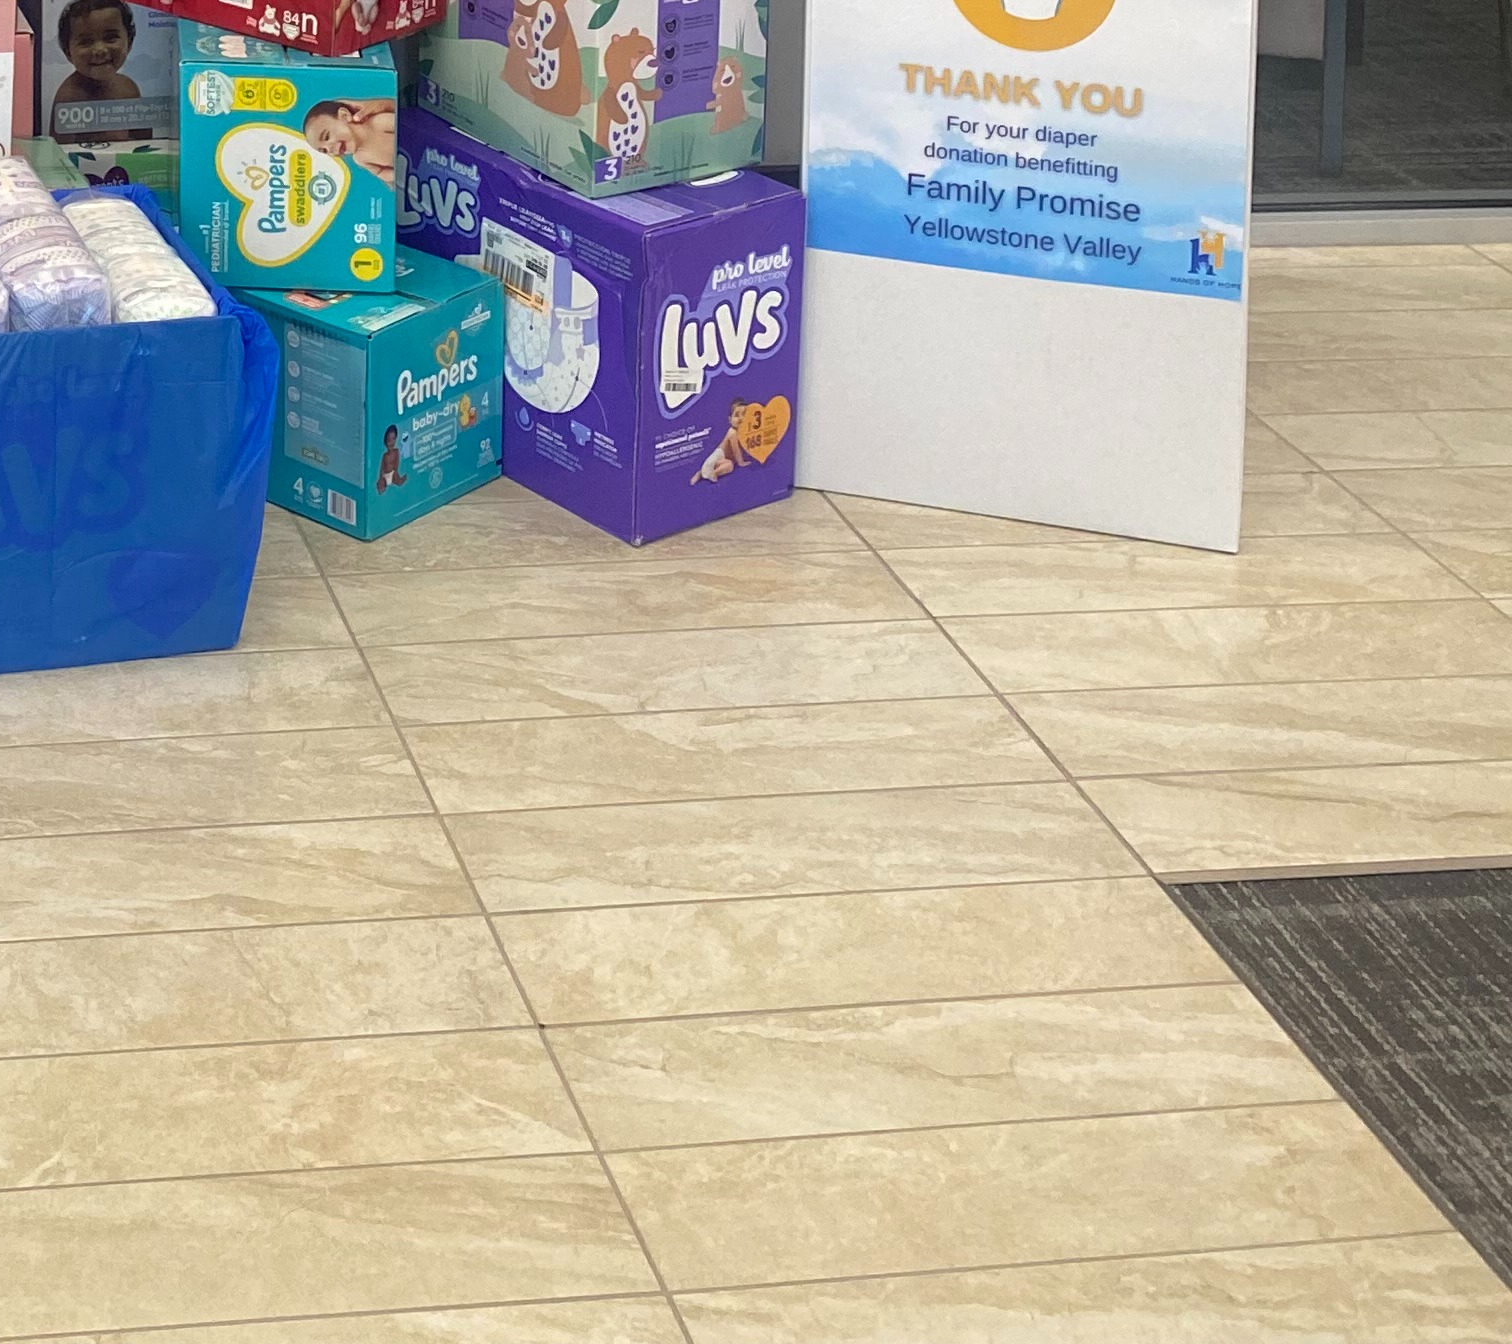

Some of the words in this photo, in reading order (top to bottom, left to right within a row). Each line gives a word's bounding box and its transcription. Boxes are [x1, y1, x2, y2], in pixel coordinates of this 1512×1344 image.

[899, 62, 1042, 107] THANK
[1053, 80, 1145, 116] YOU
[56, 107, 95, 124] 900
[945, 115, 980, 135] For
[984, 122, 1028, 142] your
[1034, 126, 1098, 150] diaper
[924, 140, 1009, 167] donation
[1014, 149, 1119, 182] benefitting
[256, 143, 291, 234] Pampers
[292, 152, 307, 225] swaddlers
[906, 173, 1006, 212] Family
[1015, 185, 1141, 224] Promise
[198, 224, 210, 235] #1
[210, 201, 222, 273] PEDIATRICIAN
[354, 223, 368, 244] 96
[903, 214, 1056, 254] Yellowstone
[1062, 232, 1142, 267] Valley
[711, 263, 745, 291] pro
[748, 246, 791, 274] level
[1169, 274, 1202, 286] HANDS
[1204, 277, 1215, 287] OF
[1217, 279, 1242, 291] HOPE
[396, 354, 479, 416] Pampers
[412, 400, 460, 432] baby-dry
